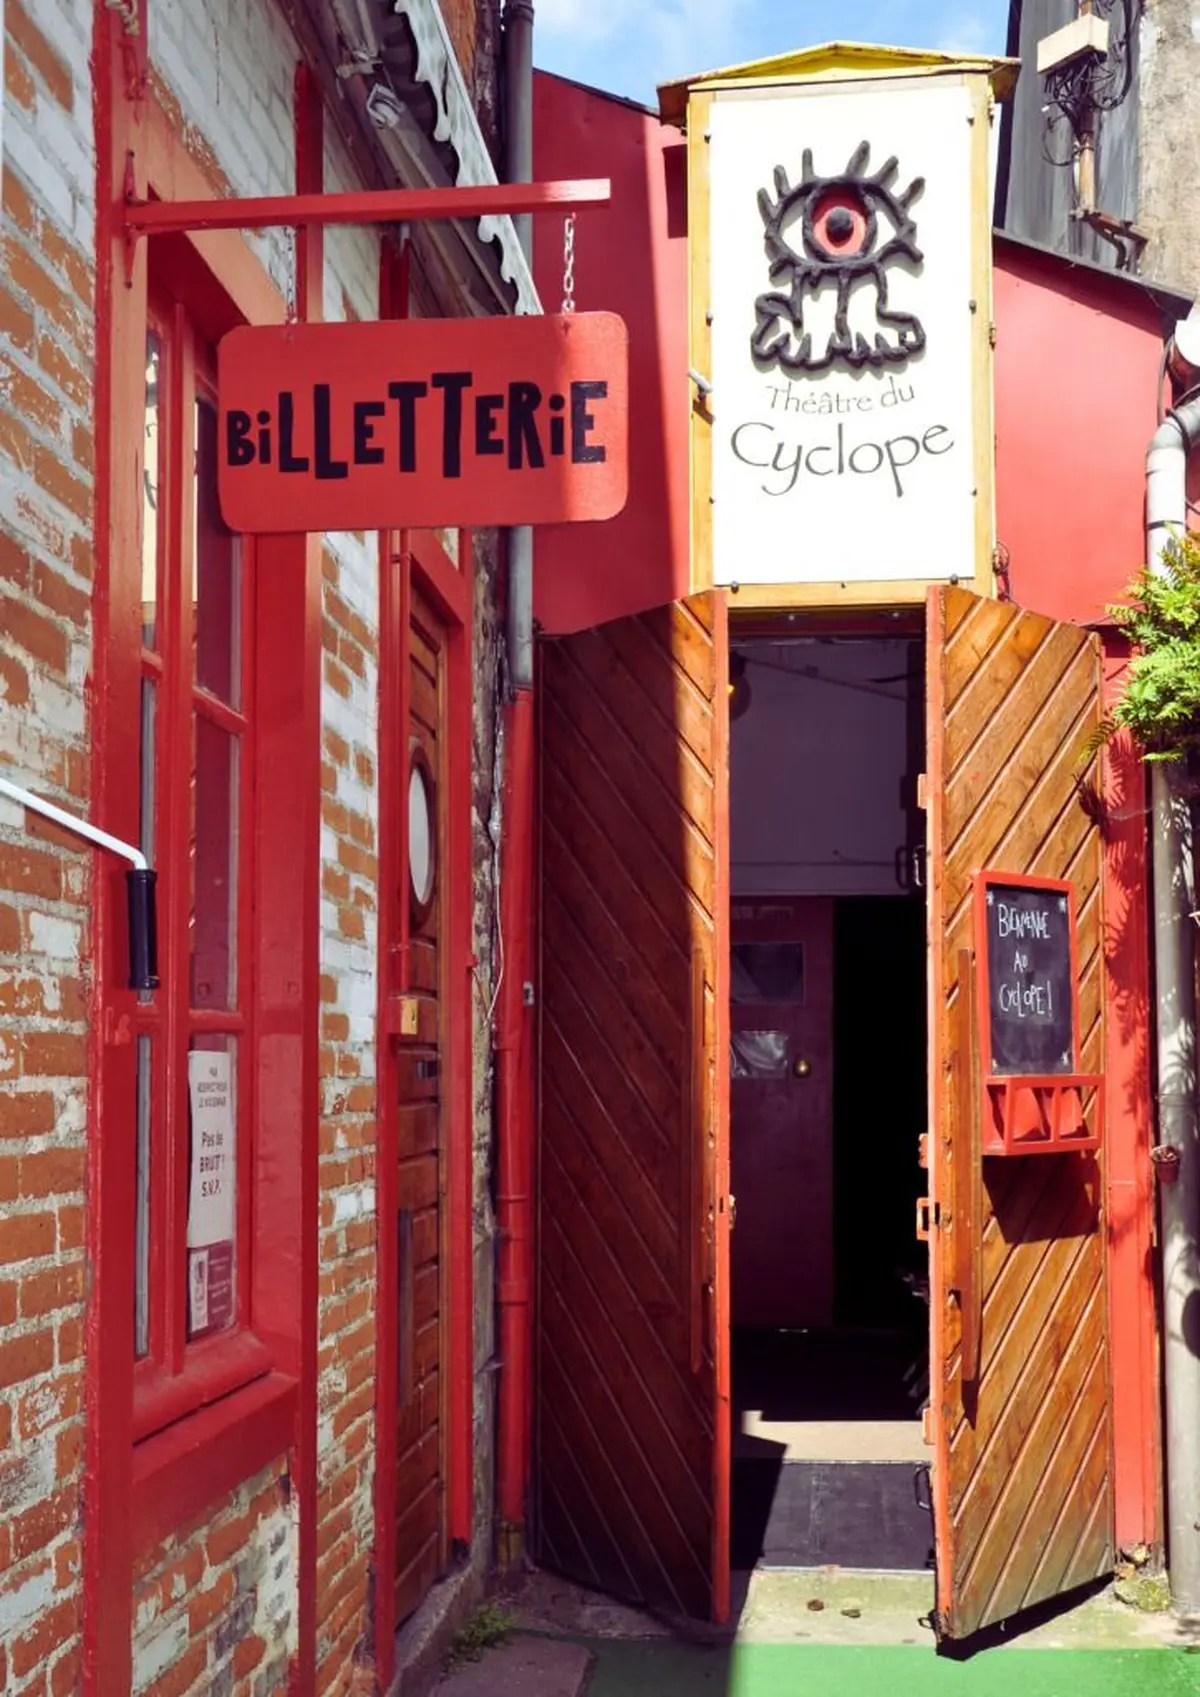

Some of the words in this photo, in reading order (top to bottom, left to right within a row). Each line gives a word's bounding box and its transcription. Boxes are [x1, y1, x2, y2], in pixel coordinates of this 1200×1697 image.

[765, 380, 875, 415] Théâtre
[880, 375, 915, 408] du
[730, 421, 955, 498] Cyclope
